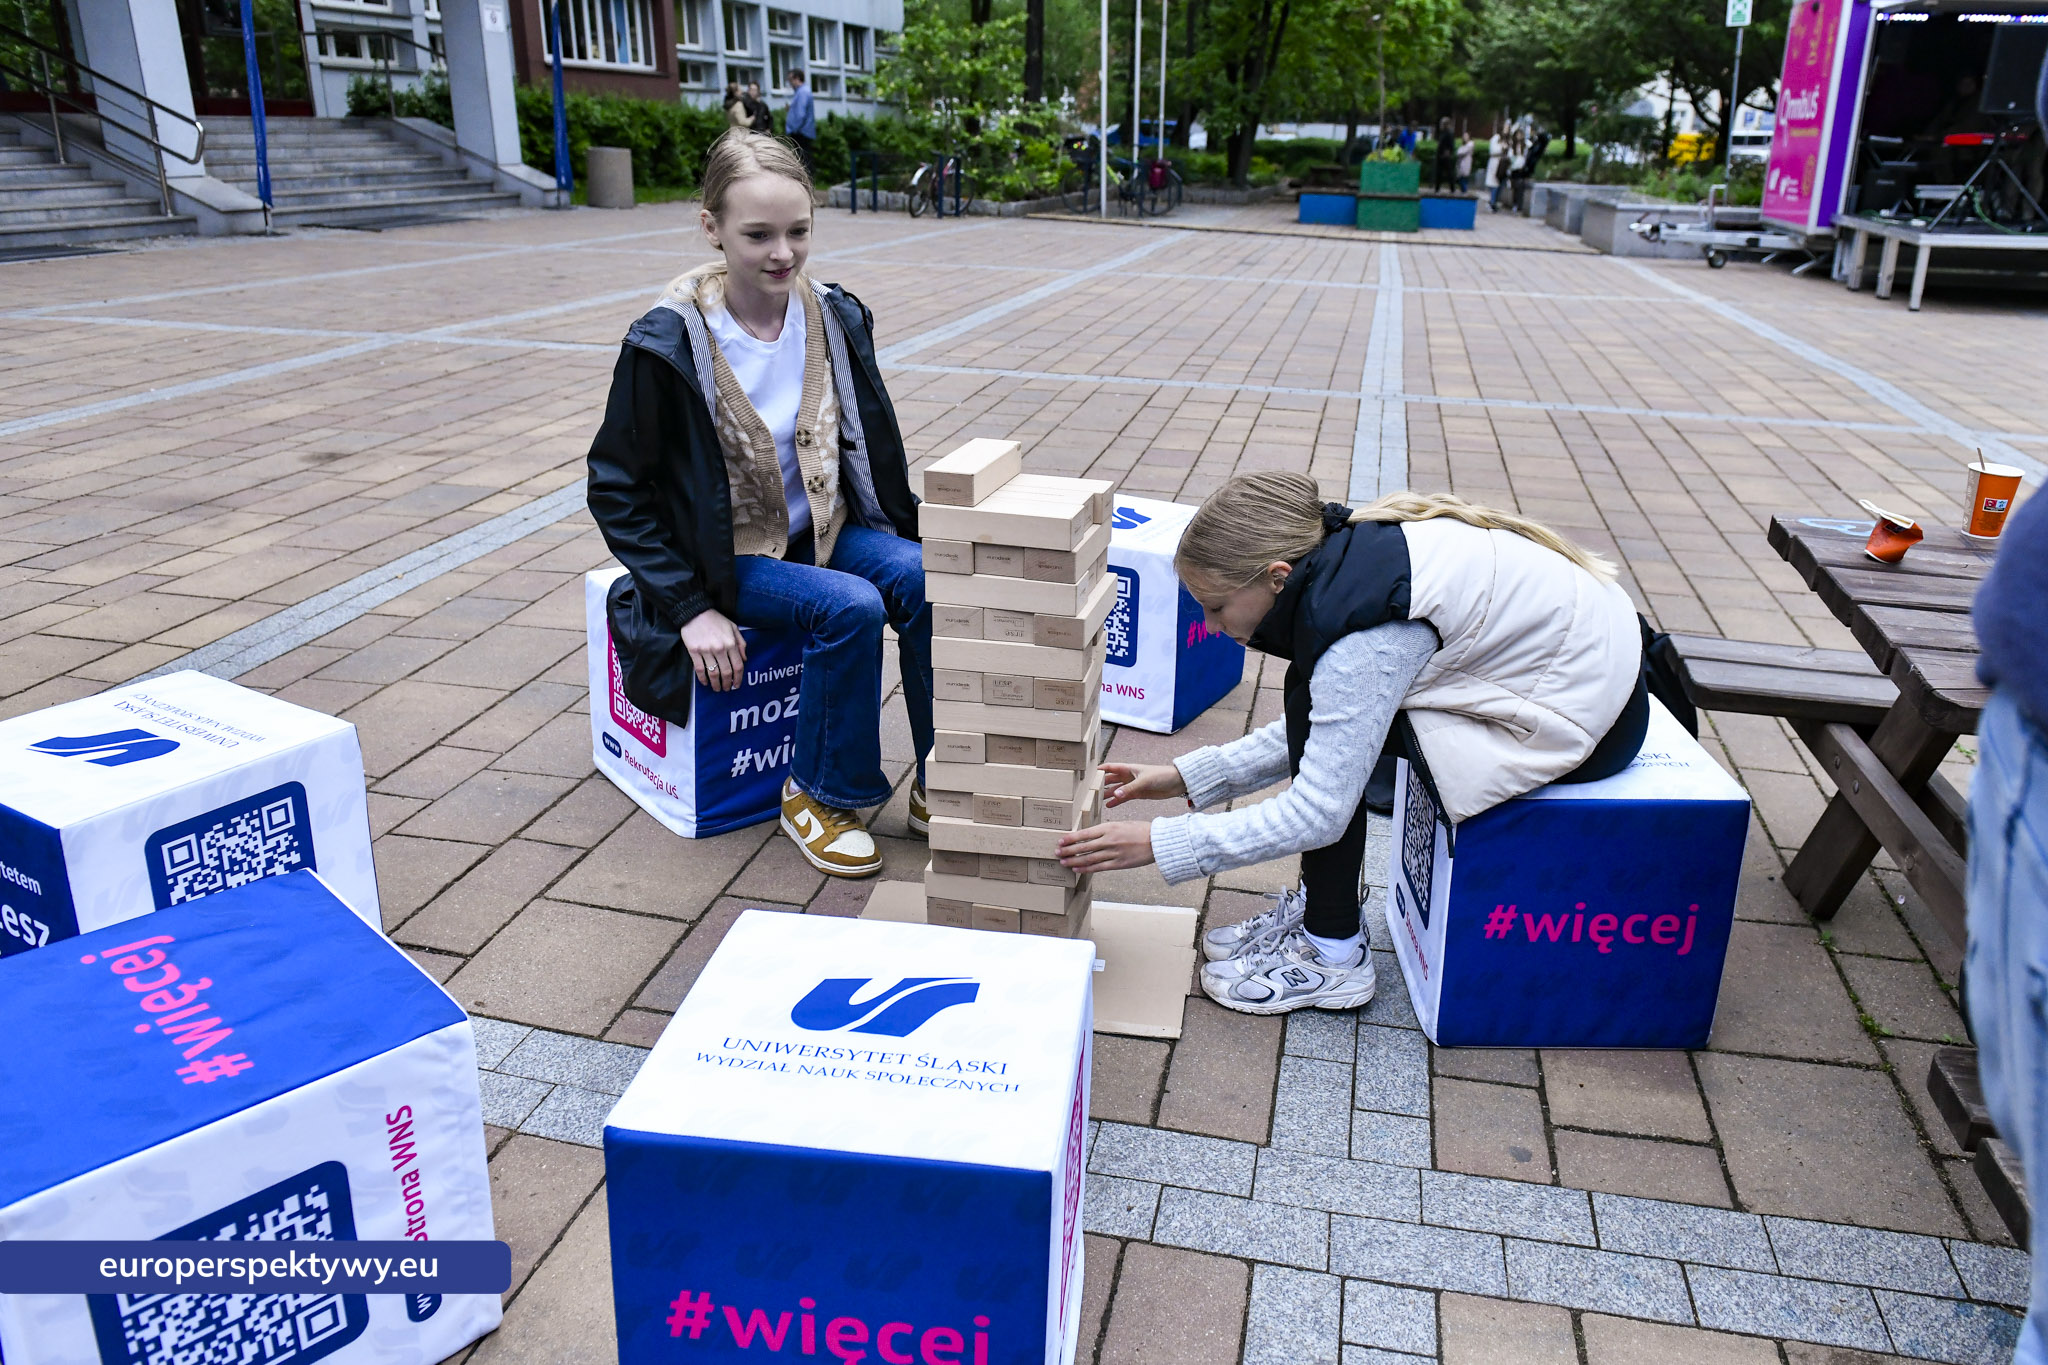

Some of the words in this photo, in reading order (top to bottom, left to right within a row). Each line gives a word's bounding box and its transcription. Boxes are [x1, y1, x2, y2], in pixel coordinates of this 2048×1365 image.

[1116, 683, 1145, 700] WNS
[625, 749, 663, 790] Rekrutacja
[731, 735, 796, 778] #wi
[0, 904, 50, 947] esz
[1483, 902, 1700, 955] #więcej
[1280, 967, 1309, 988] N
[80, 935, 254, 1085] #więcej
[696, 1052, 791, 1073] WYDZIAŁ
[797, 1064, 859, 1079] NAUK
[864, 1070, 1020, 1093] SPOŁECZNYCH
[722, 1037, 911, 1065] UNIWERSYTET
[914, 1052, 1009, 1076] ŚLĄSKI
[386, 1105, 417, 1172] WNS
[666, 1289, 990, 1365] #więcej
